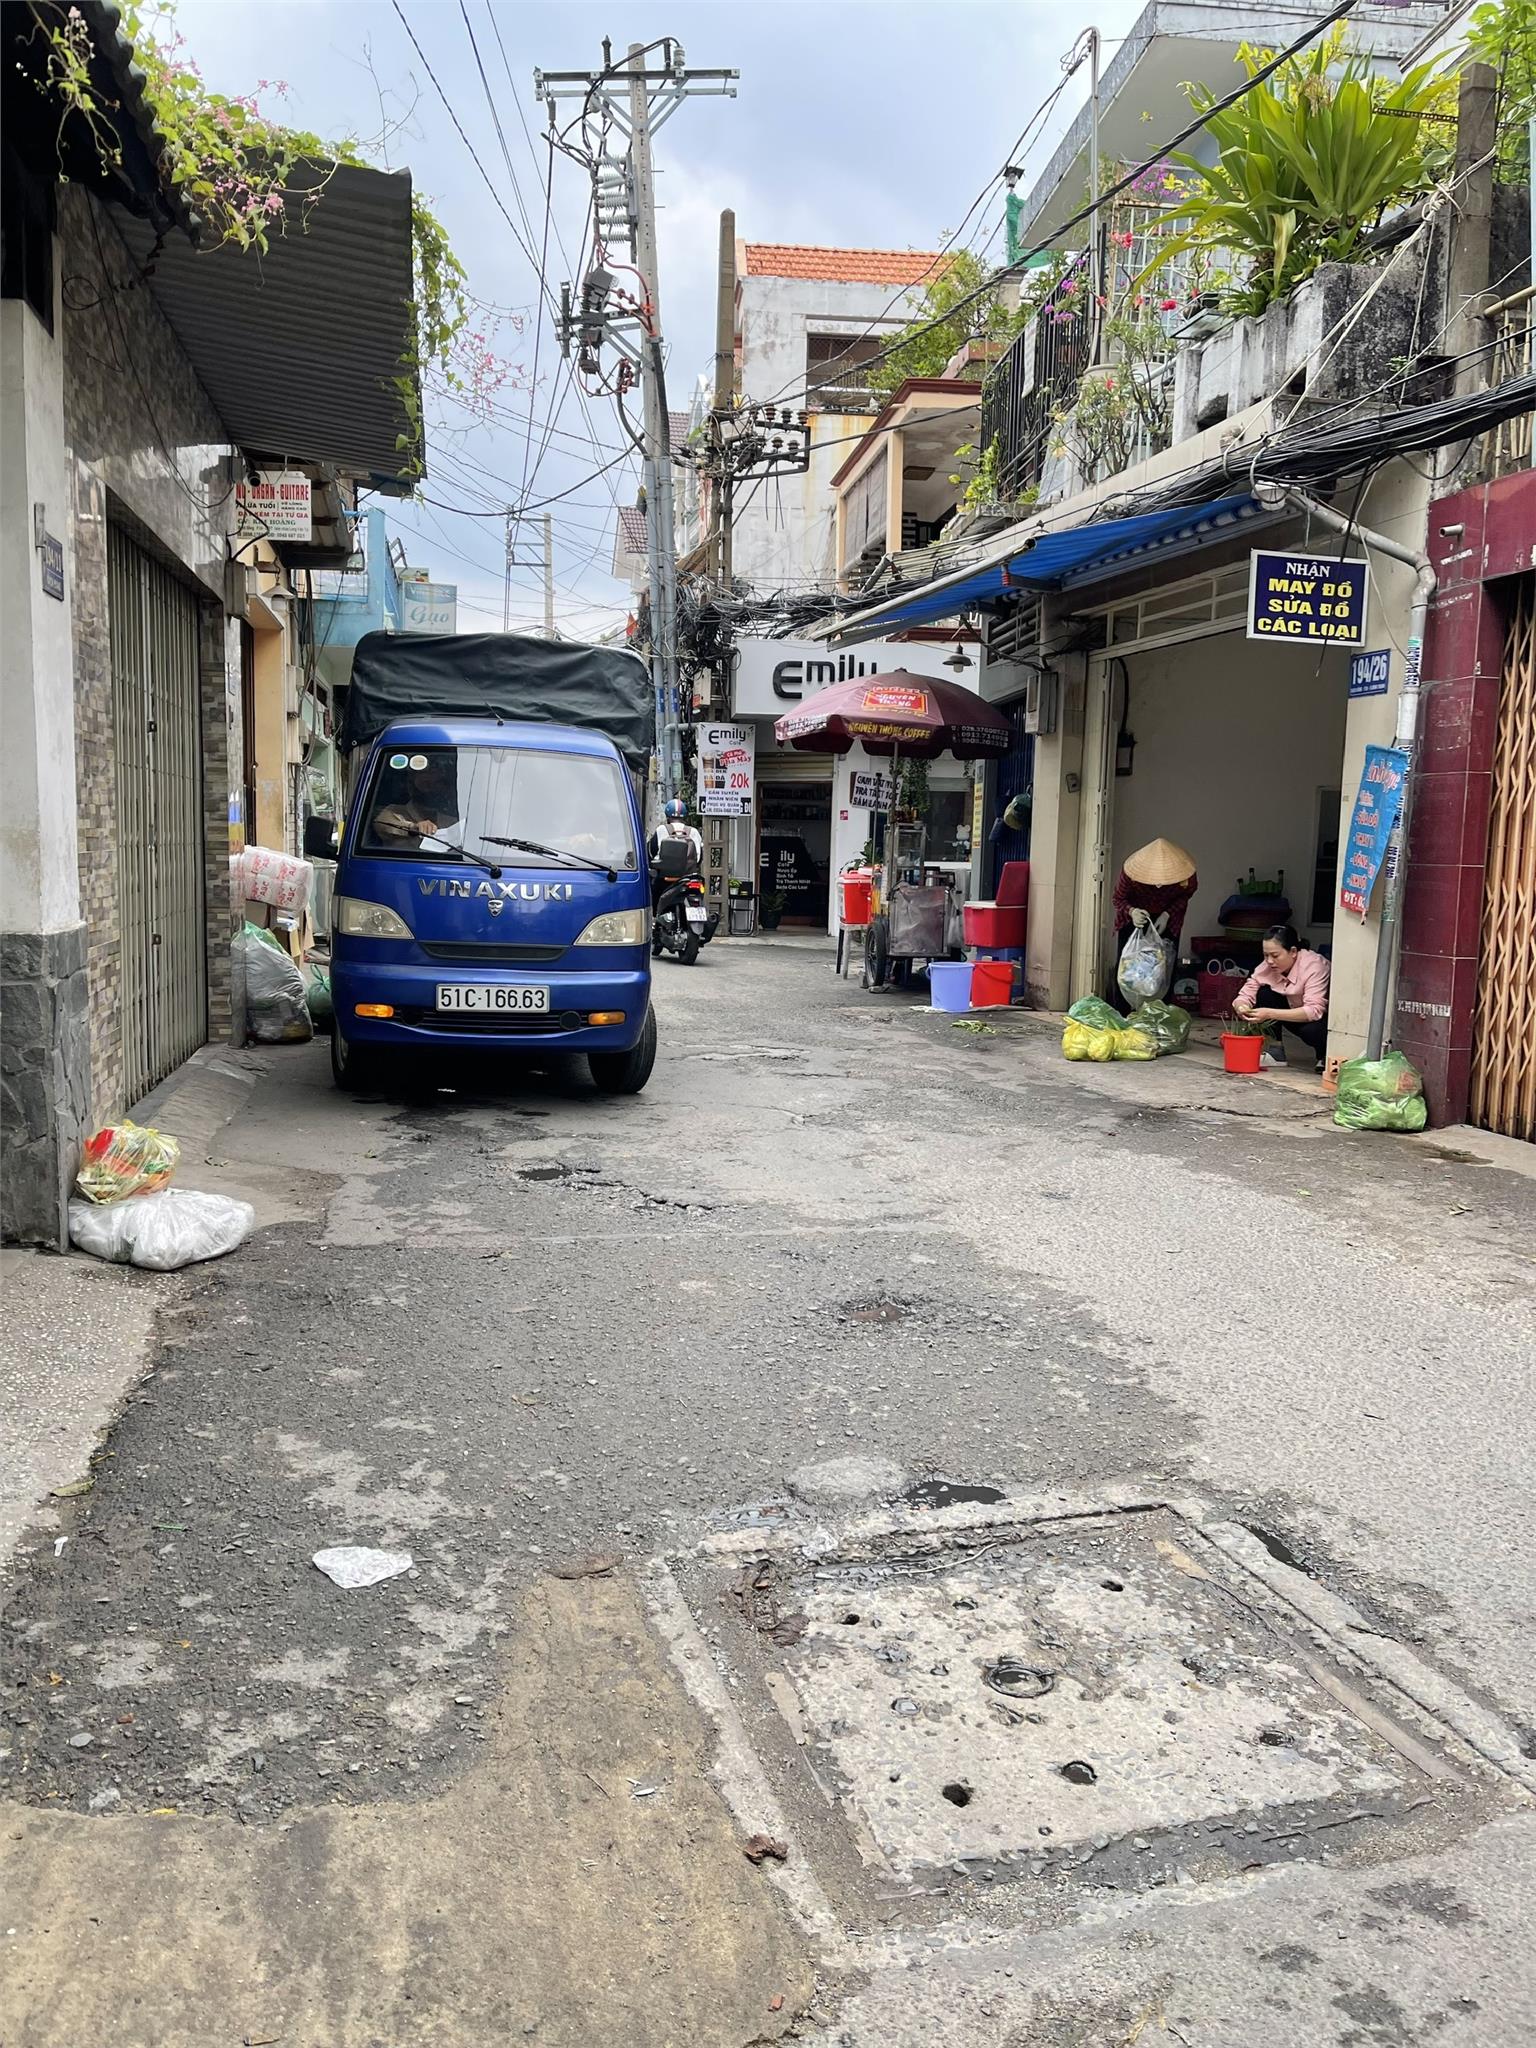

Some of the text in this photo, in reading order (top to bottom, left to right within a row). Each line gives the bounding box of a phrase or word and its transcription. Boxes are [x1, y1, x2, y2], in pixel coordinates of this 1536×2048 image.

[280, 484, 309, 500] GUITARE
[1286, 562, 1330, 580] NHẬN
[1268, 578, 1317, 595] MAY
[1268, 595, 1313, 615] SỬA
[1257, 616, 1358, 640] CÁC LOẠI
[1352, 654, 1388, 685] 194/26
[708, 728, 746, 745] Emily
[904, 728, 932, 740] COFFEE
[730, 773, 750, 788] 20k
[418, 878, 573, 901] VINAXUKI
[441, 988, 545, 1009] 51C-166.63
